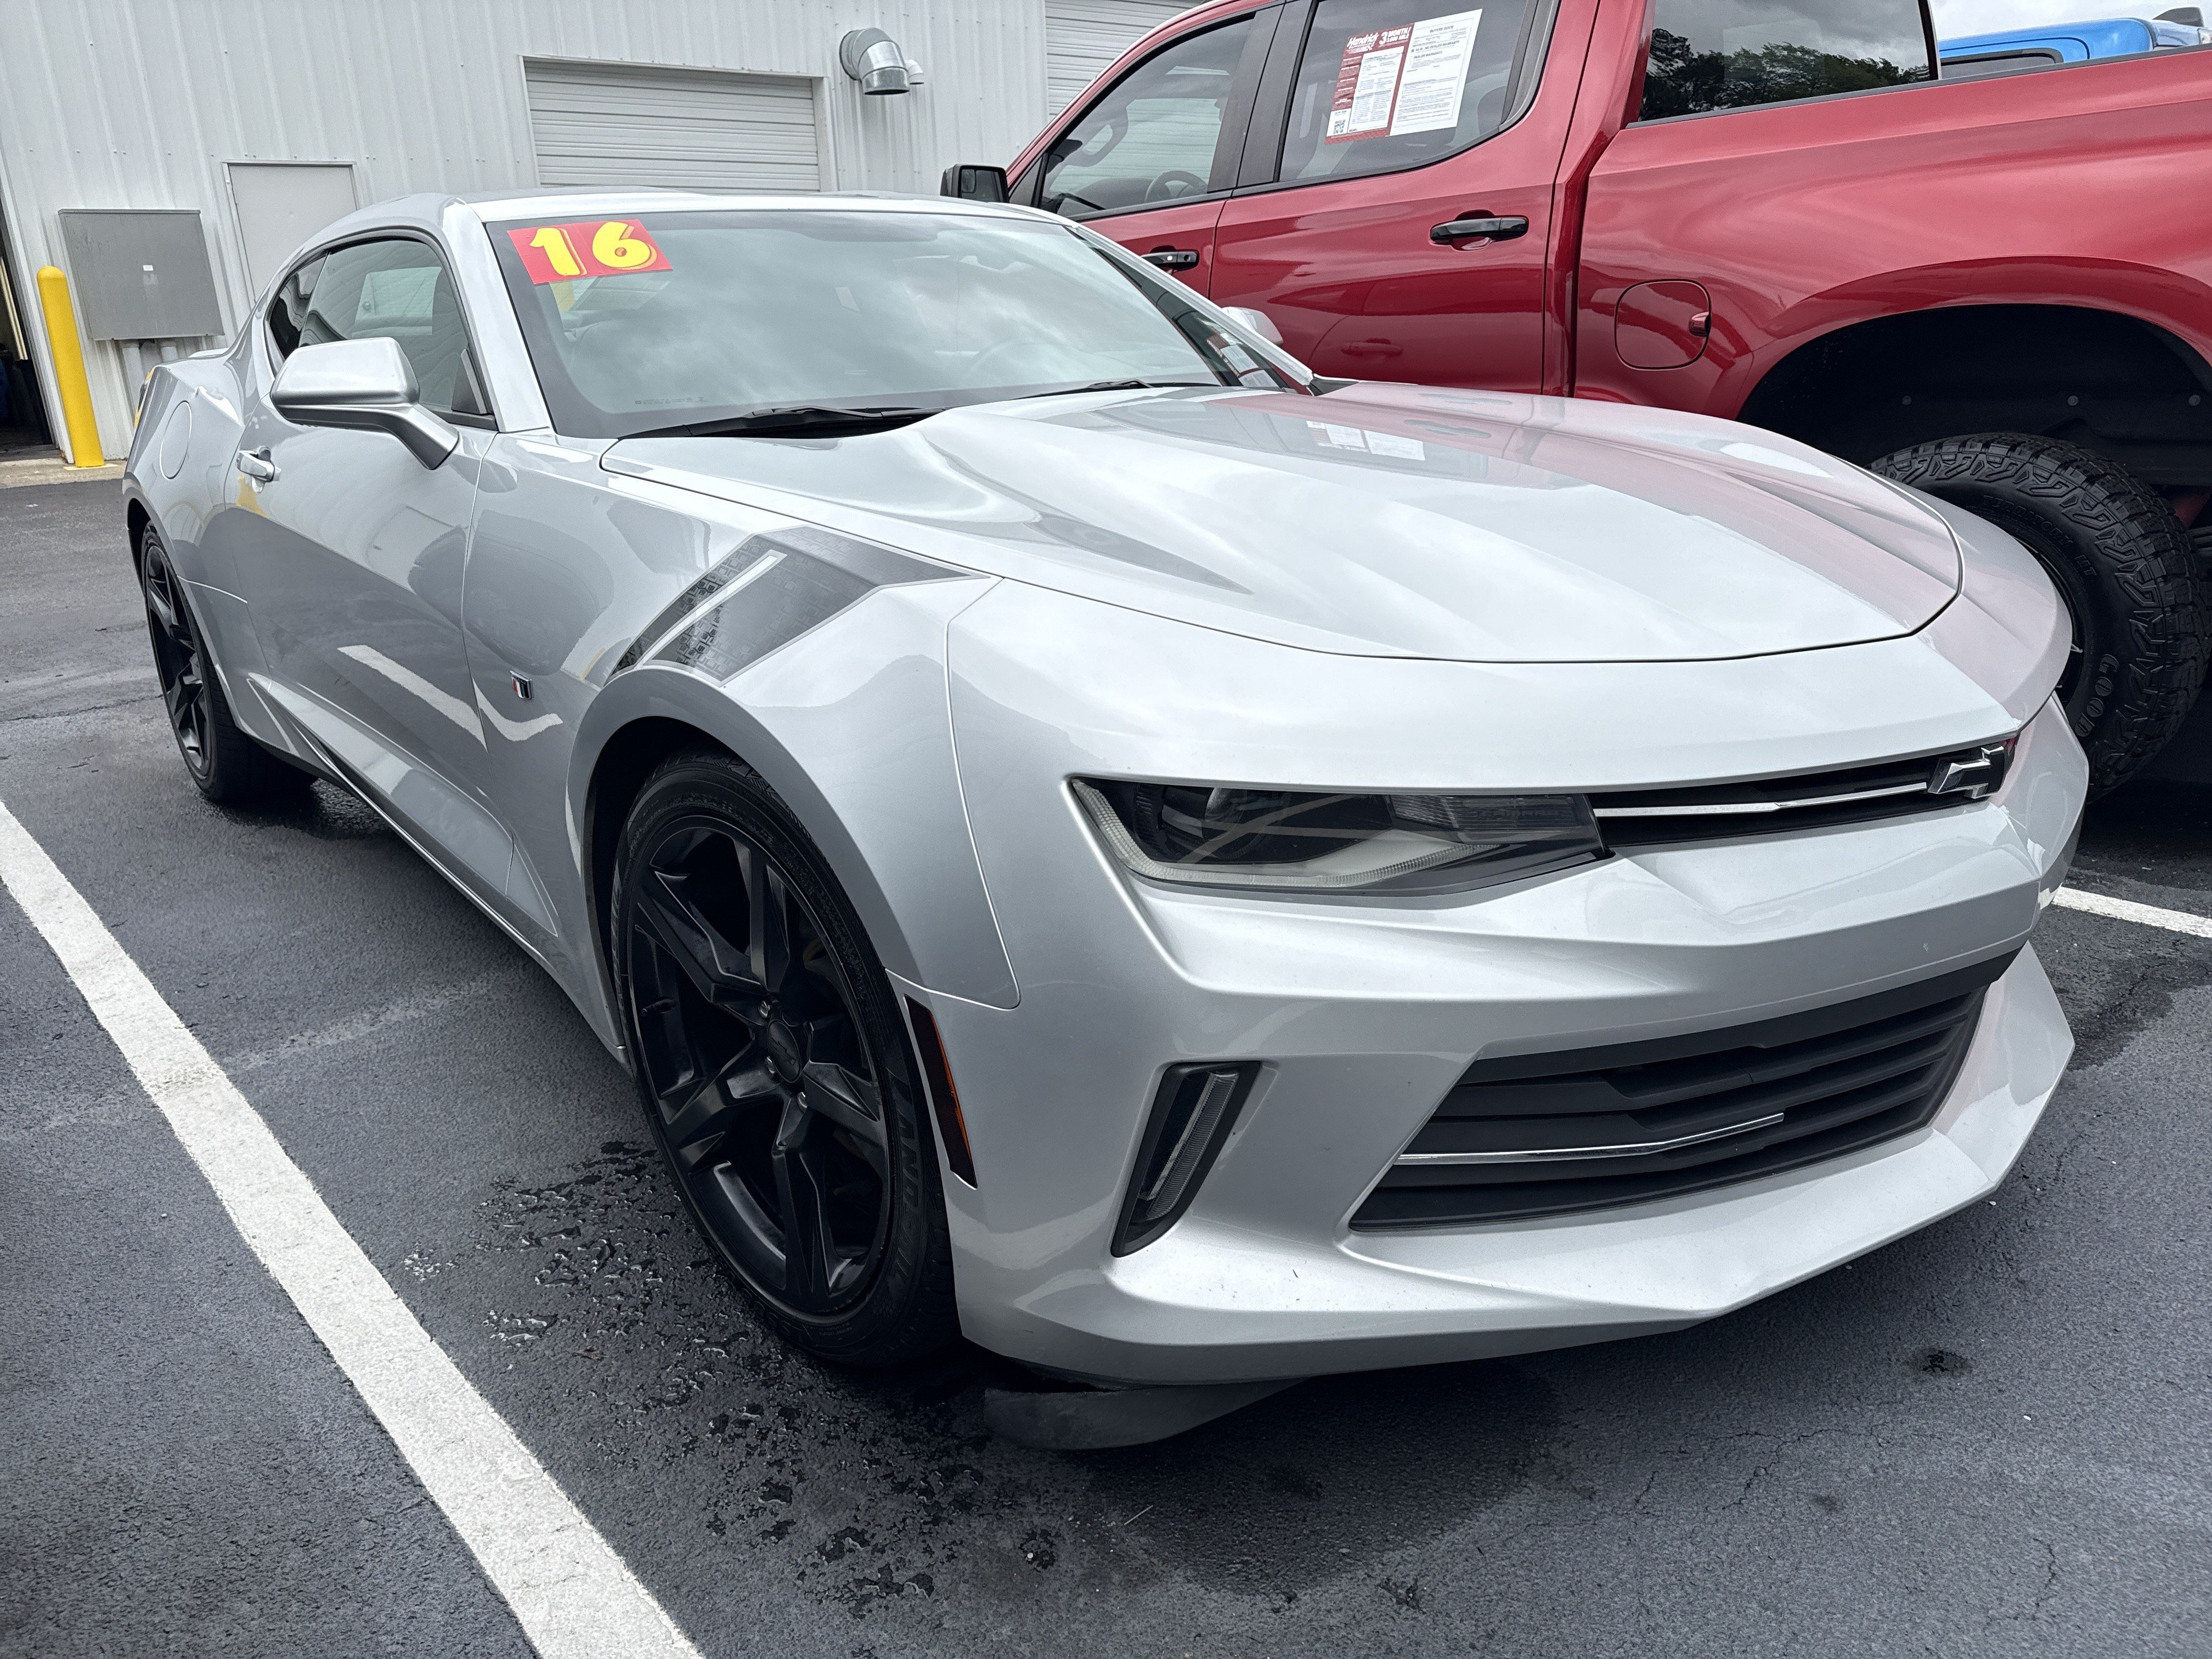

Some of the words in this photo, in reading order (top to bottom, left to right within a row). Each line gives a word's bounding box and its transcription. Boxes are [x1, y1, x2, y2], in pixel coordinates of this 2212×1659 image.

[1346, 32, 1379, 49] Hendrick
[1379, 31, 1389, 45] 3
[529, 221, 657, 276] 16
[1983, 494, 2074, 545] TERRITORY
